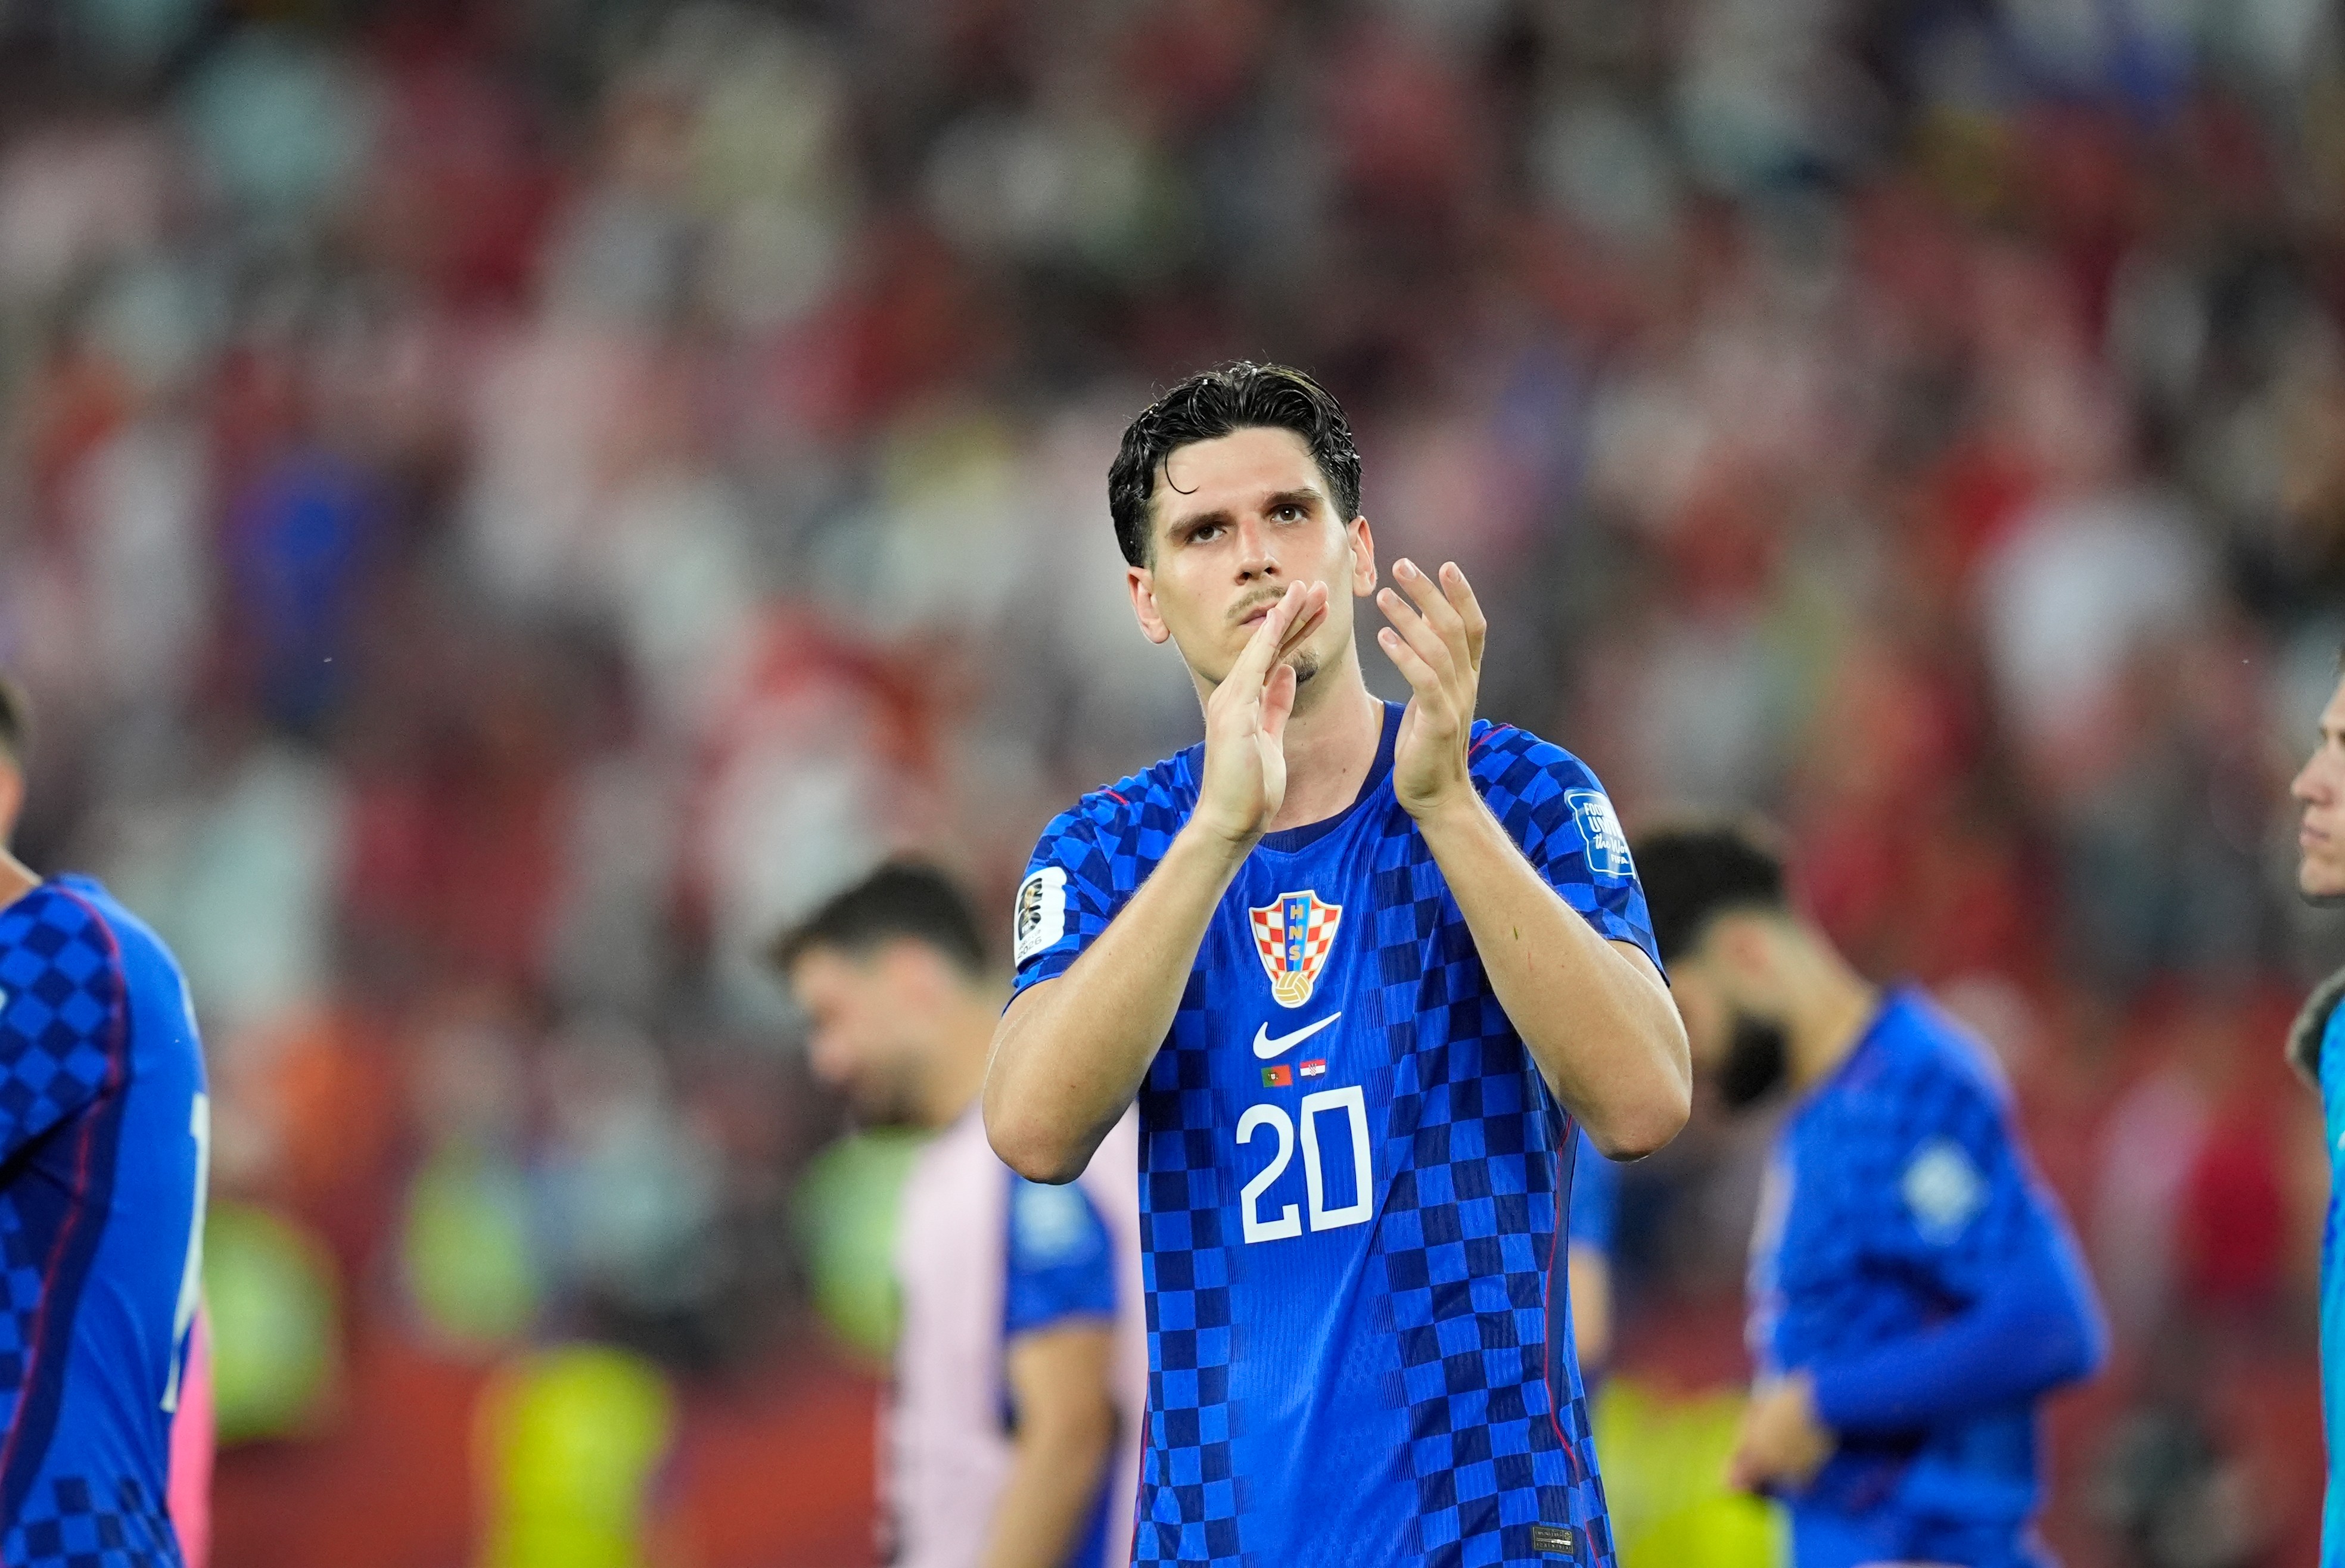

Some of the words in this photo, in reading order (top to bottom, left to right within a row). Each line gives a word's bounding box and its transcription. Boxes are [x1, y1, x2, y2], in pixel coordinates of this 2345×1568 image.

[1593, 833, 1611, 850] the
[1610, 854, 1629, 864] FIFA
[1289, 904, 1304, 961] HNS
[1017, 936, 1042, 959] 2026
[1236, 1085, 1373, 1244] 20
